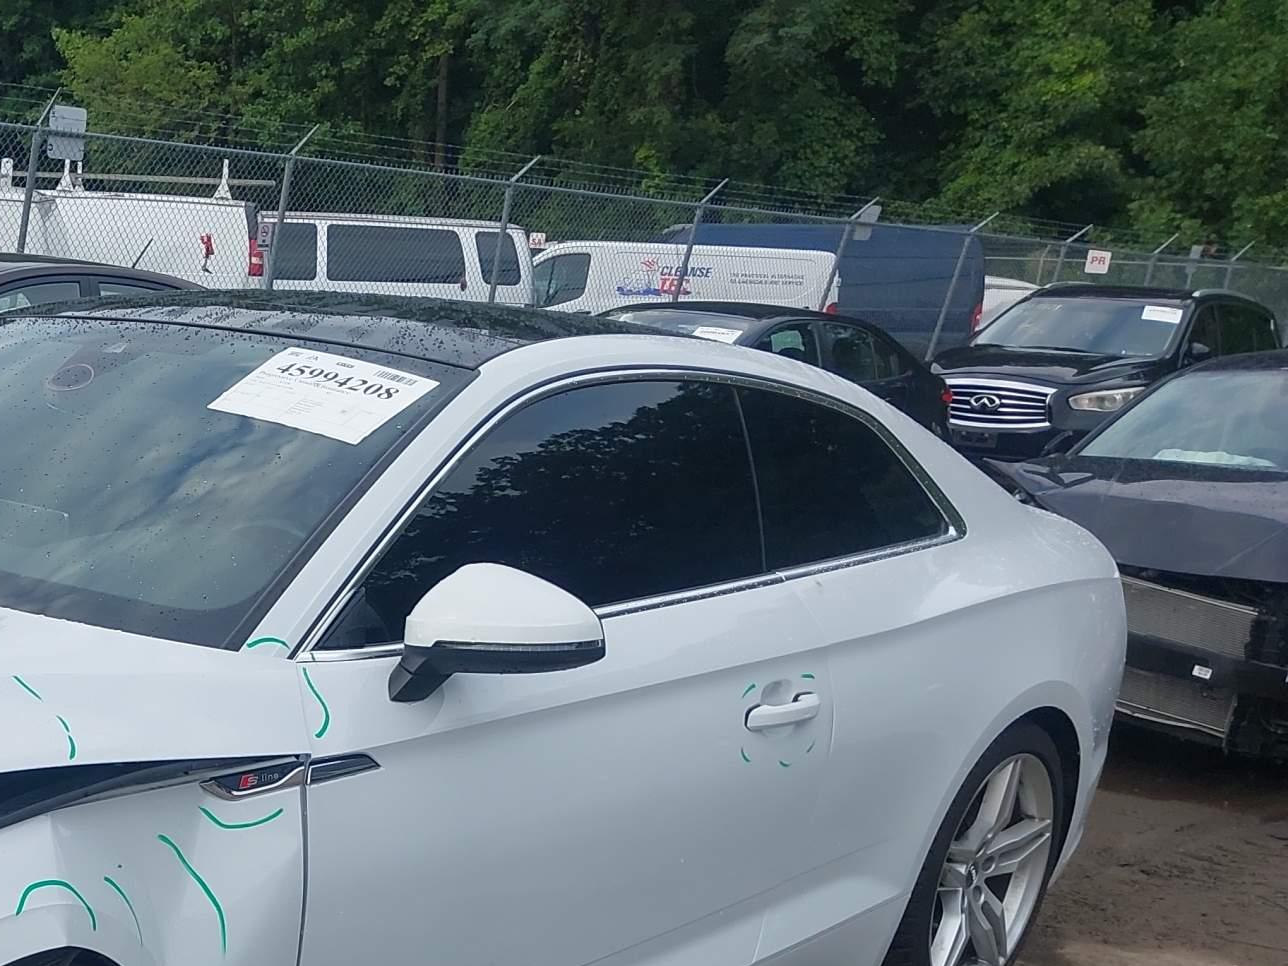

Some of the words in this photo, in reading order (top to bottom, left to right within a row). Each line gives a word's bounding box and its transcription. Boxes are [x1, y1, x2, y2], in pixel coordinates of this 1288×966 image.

[1090, 255, 1107, 265] PR
[660, 265, 713, 278] CLENSE
[276, 362, 400, 400] 45994208
[244, 774, 258, 787] S
[261, 772, 279, 783] line
